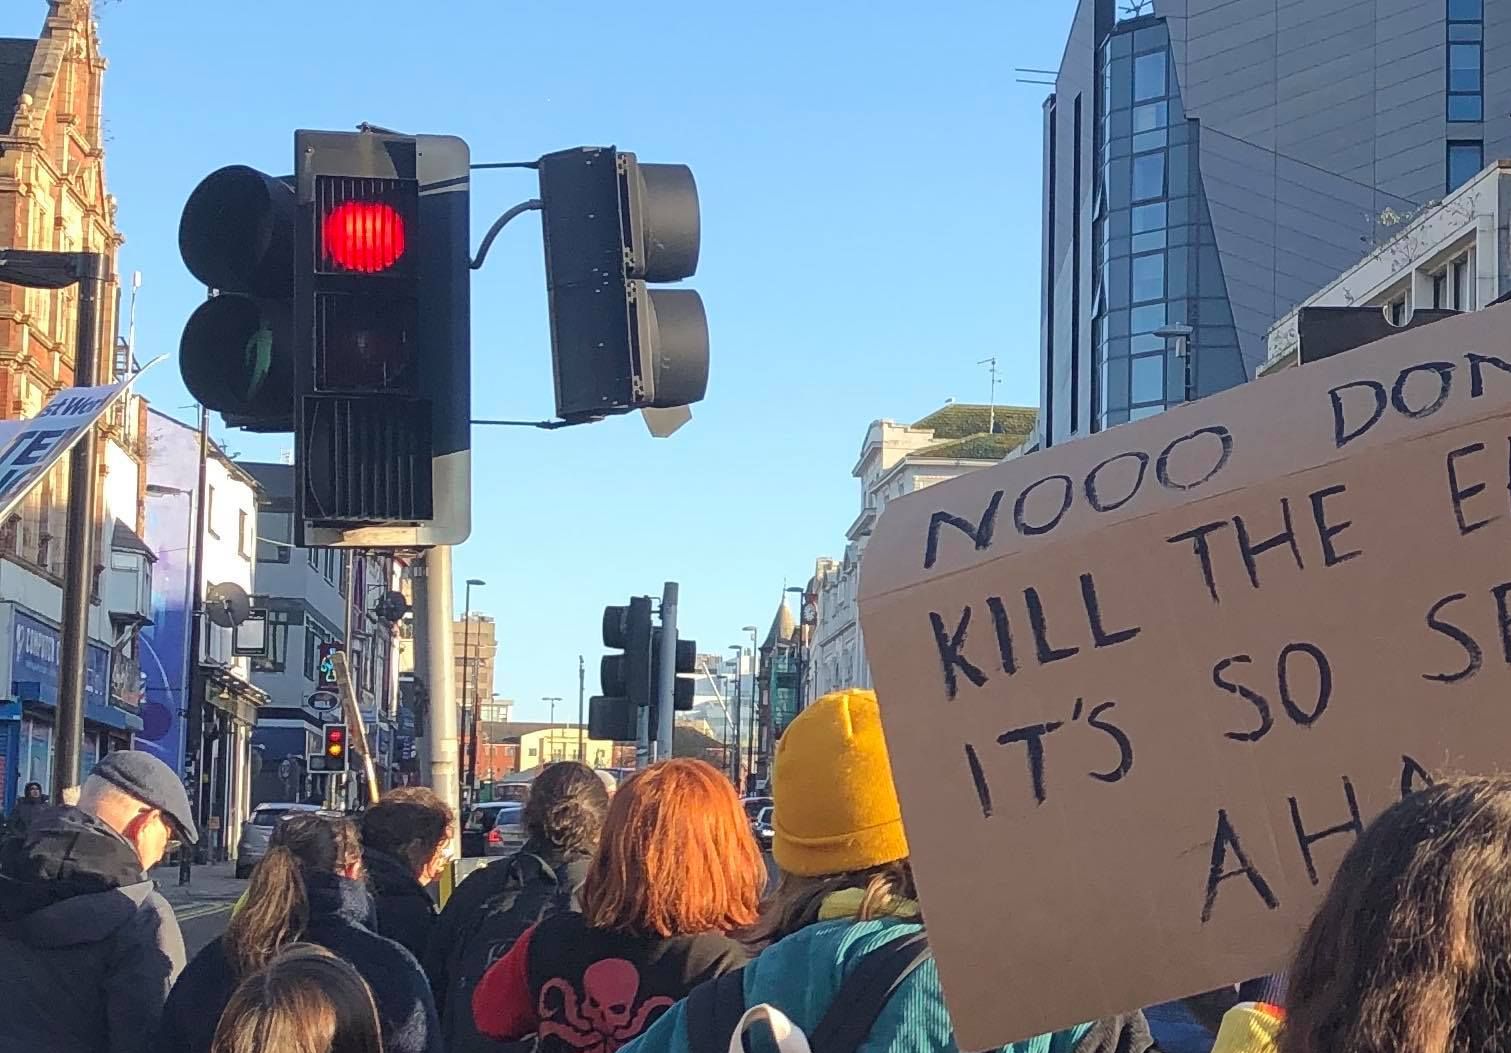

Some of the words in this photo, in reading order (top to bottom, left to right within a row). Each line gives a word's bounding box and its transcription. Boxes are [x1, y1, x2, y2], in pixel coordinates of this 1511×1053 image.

[923, 425, 1234, 570] NOOO
[928, 572, 1142, 701] KILL
[1165, 484, 1364, 604] THE
[964, 698, 1134, 820] IT'S
[1212, 642, 1333, 742] SO
